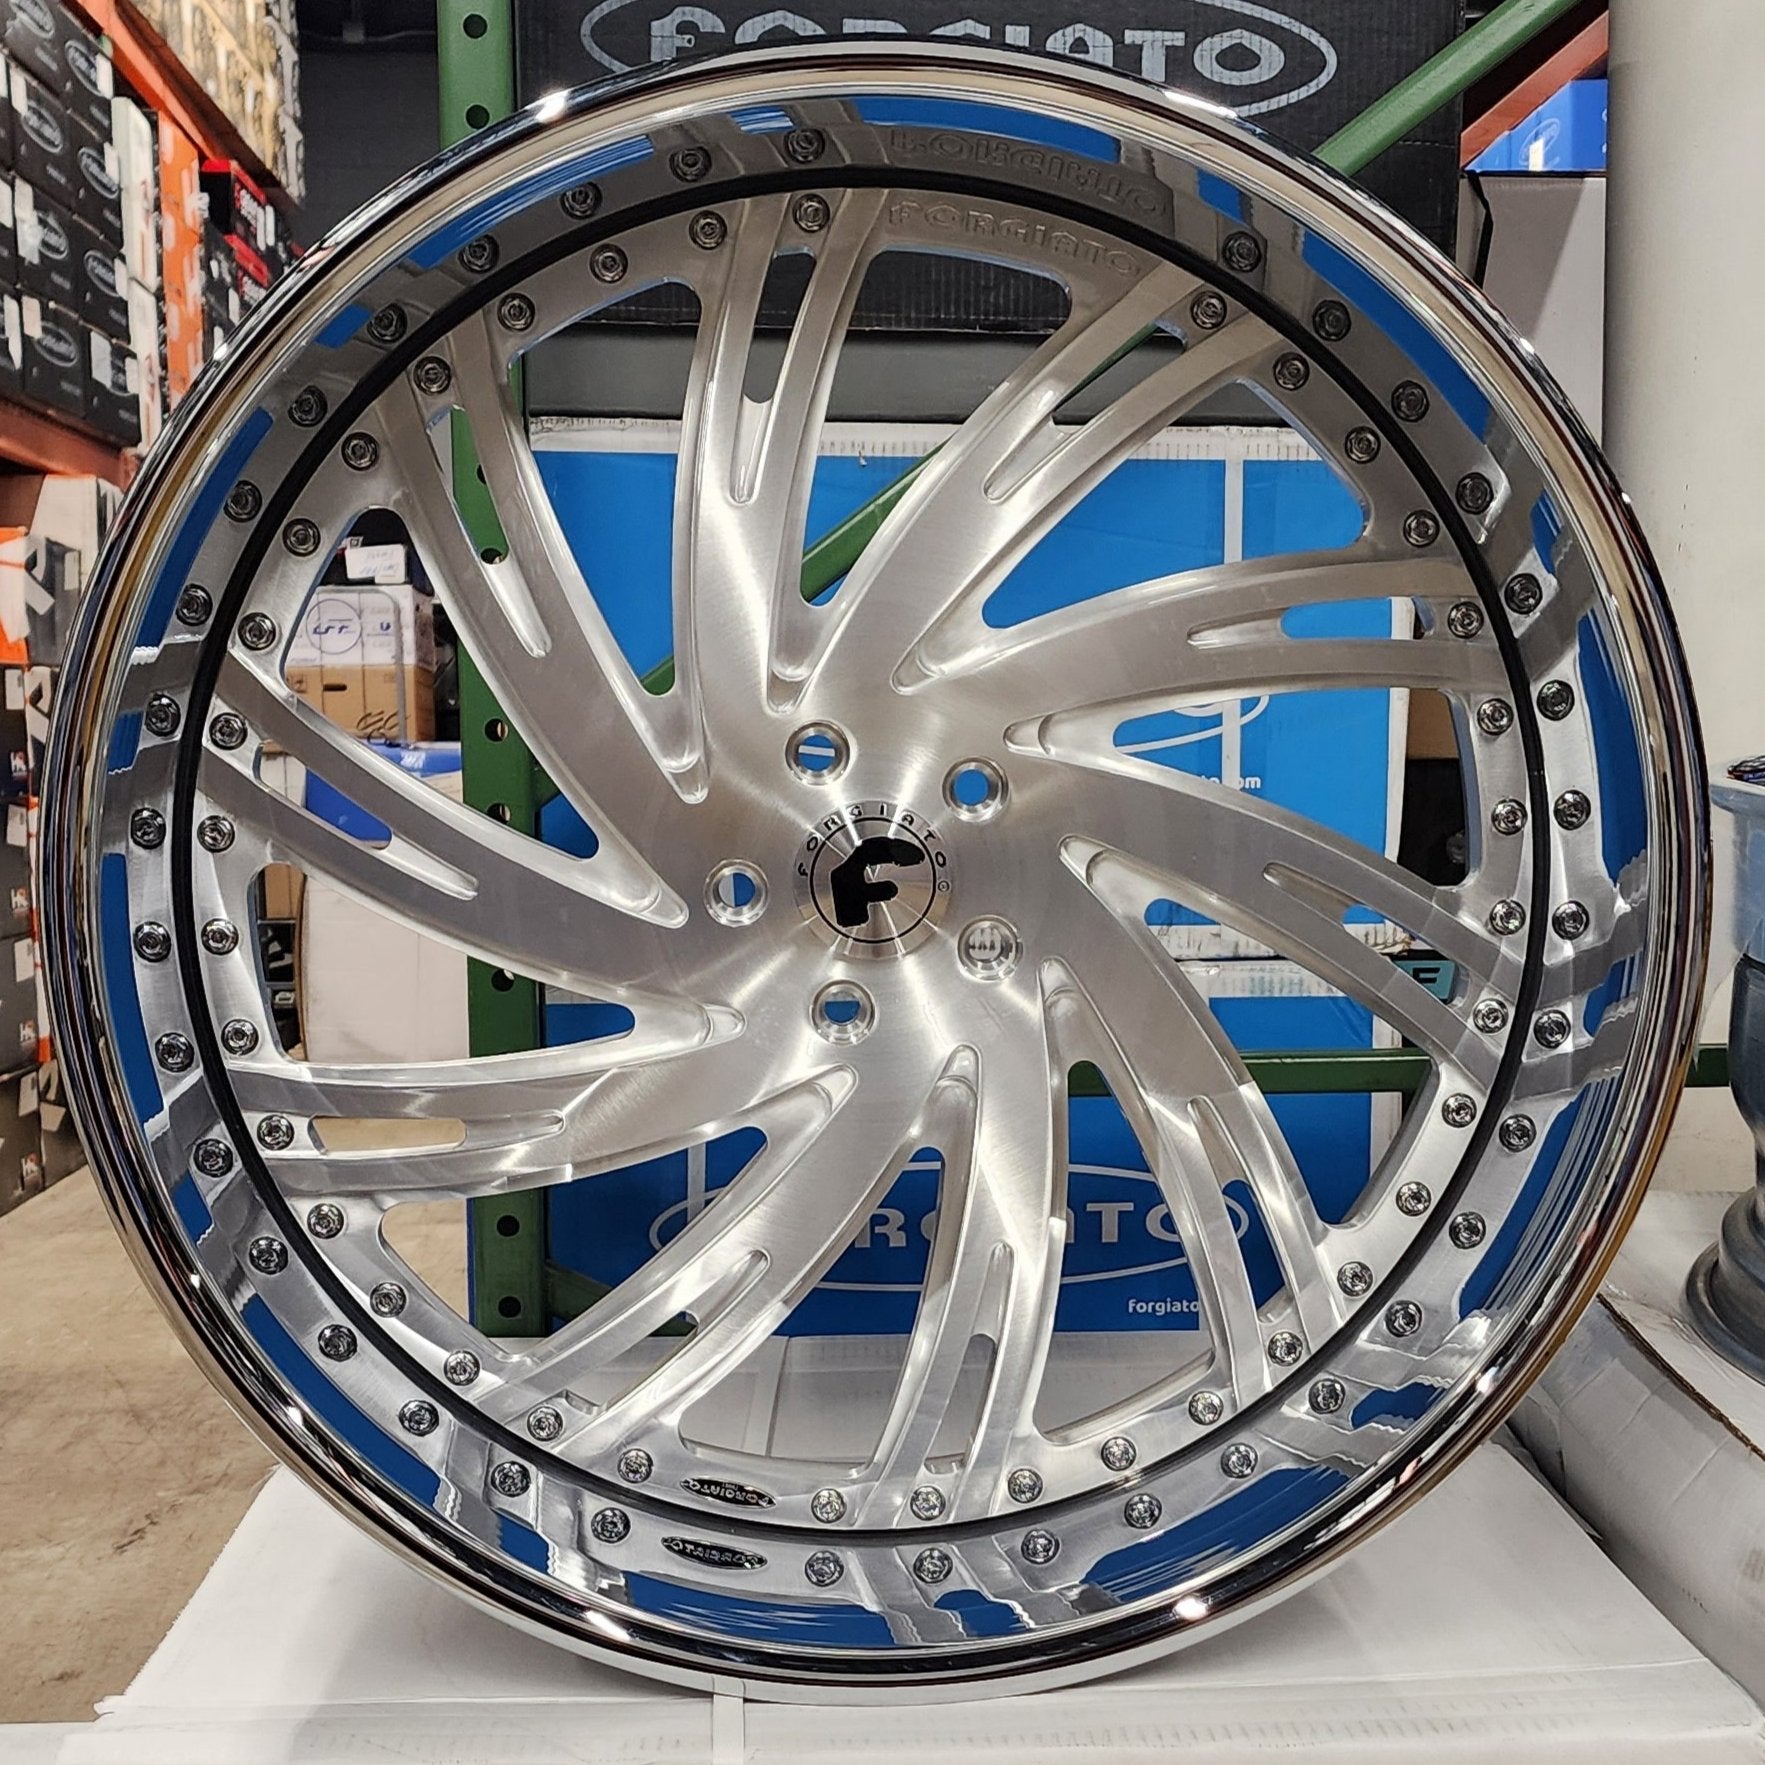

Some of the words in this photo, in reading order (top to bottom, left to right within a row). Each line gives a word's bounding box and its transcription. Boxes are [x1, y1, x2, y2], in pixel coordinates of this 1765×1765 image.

[650, 7, 1285, 86] FOATO
[889, 201, 1140, 276] FORGIATO
[798, 804, 946, 878] FORGIATO
[1128, 1298, 1200, 1315] forgiato
